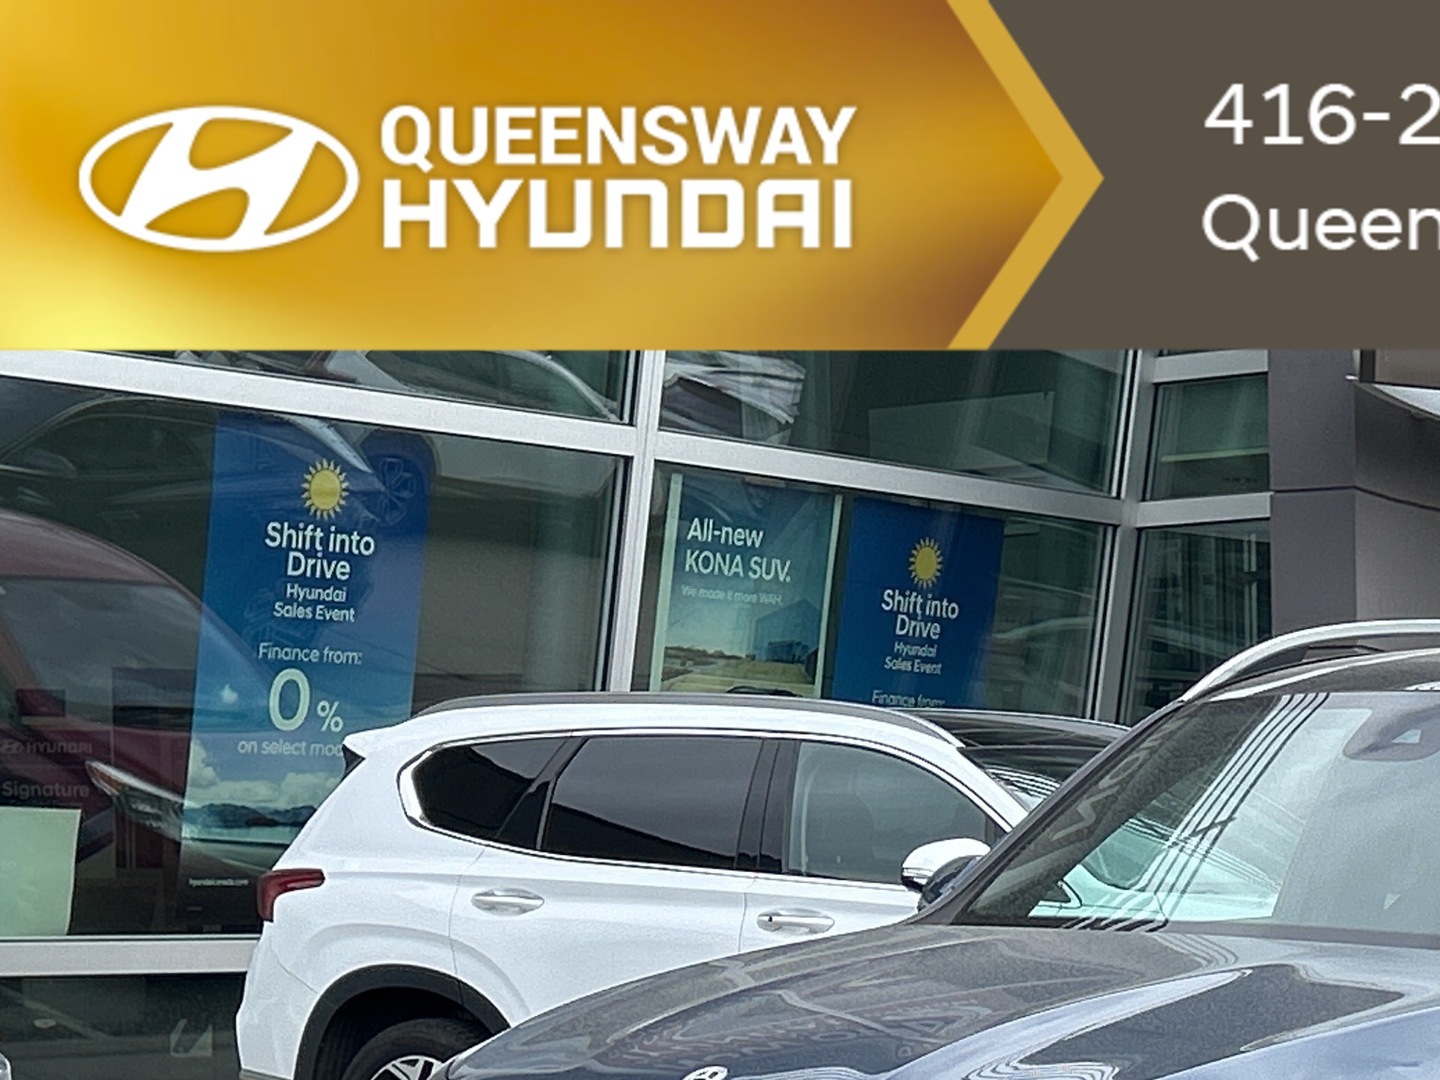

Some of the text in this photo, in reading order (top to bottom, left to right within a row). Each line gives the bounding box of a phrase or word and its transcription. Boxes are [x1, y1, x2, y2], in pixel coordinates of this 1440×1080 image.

[265, 521, 375, 556] Shift into
[687, 517, 764, 548] All-new
[287, 551, 350, 581] Drive
[685, 549, 791, 582] KONA SUV.
[286, 583, 347, 602] Hyundai
[881, 589, 959, 619] Shift into
[273, 602, 355, 622] Sales Event
[895, 614, 941, 639] Drive
[258, 642, 363, 665] Finance from:
[269, 667, 344, 732] 0 %
[237, 740, 258, 754] on
[260, 739, 306, 756] select
[1, 780, 91, 800] Signature
